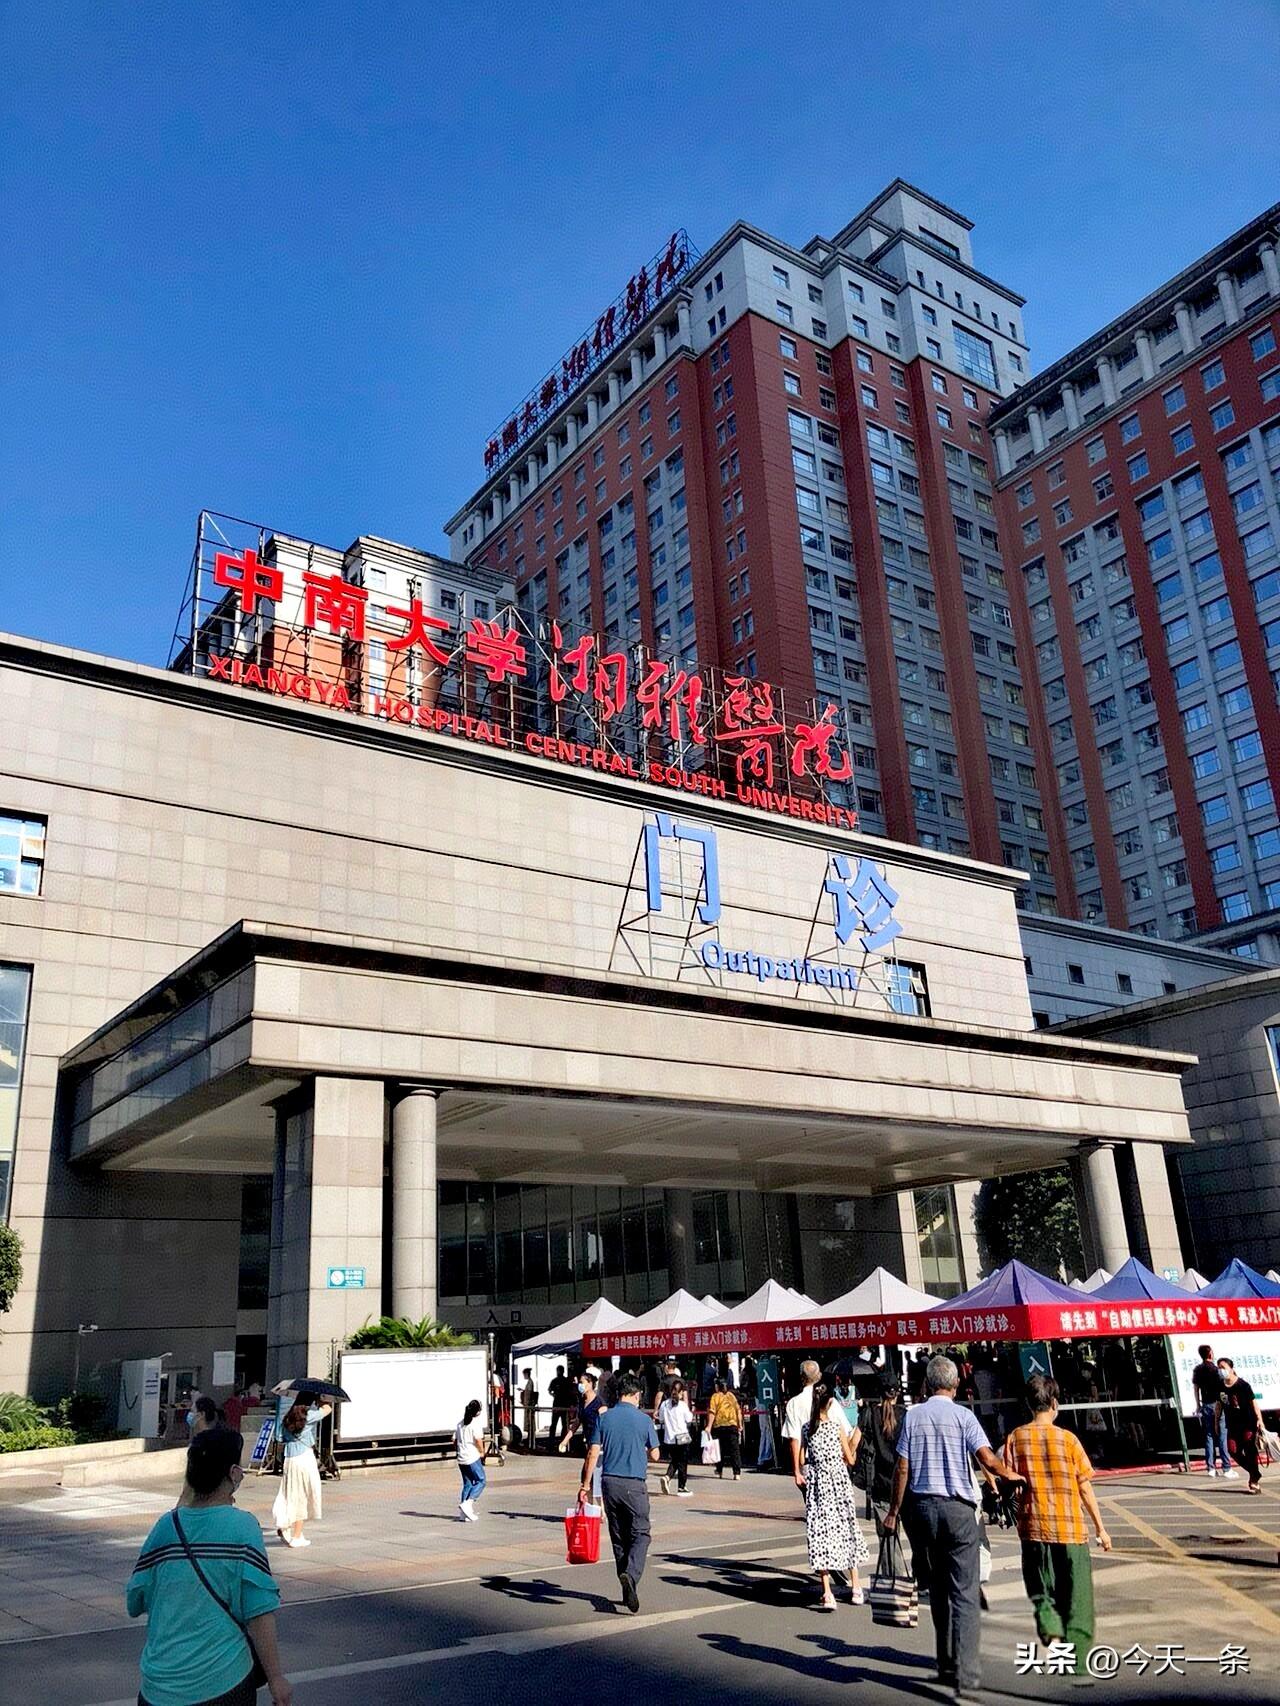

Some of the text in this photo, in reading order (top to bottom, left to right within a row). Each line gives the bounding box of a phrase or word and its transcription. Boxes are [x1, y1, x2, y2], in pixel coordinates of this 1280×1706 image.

[208, 653, 859, 829] XIANGYA HOSPITAL CENTRAL SOUTH UNIVERSITY
[645, 814, 904, 953] 门诊
[701, 940, 859, 990] Outpatient
[486, 1309, 522, 1325] 入口
[761, 1369, 773, 1400] 入口
